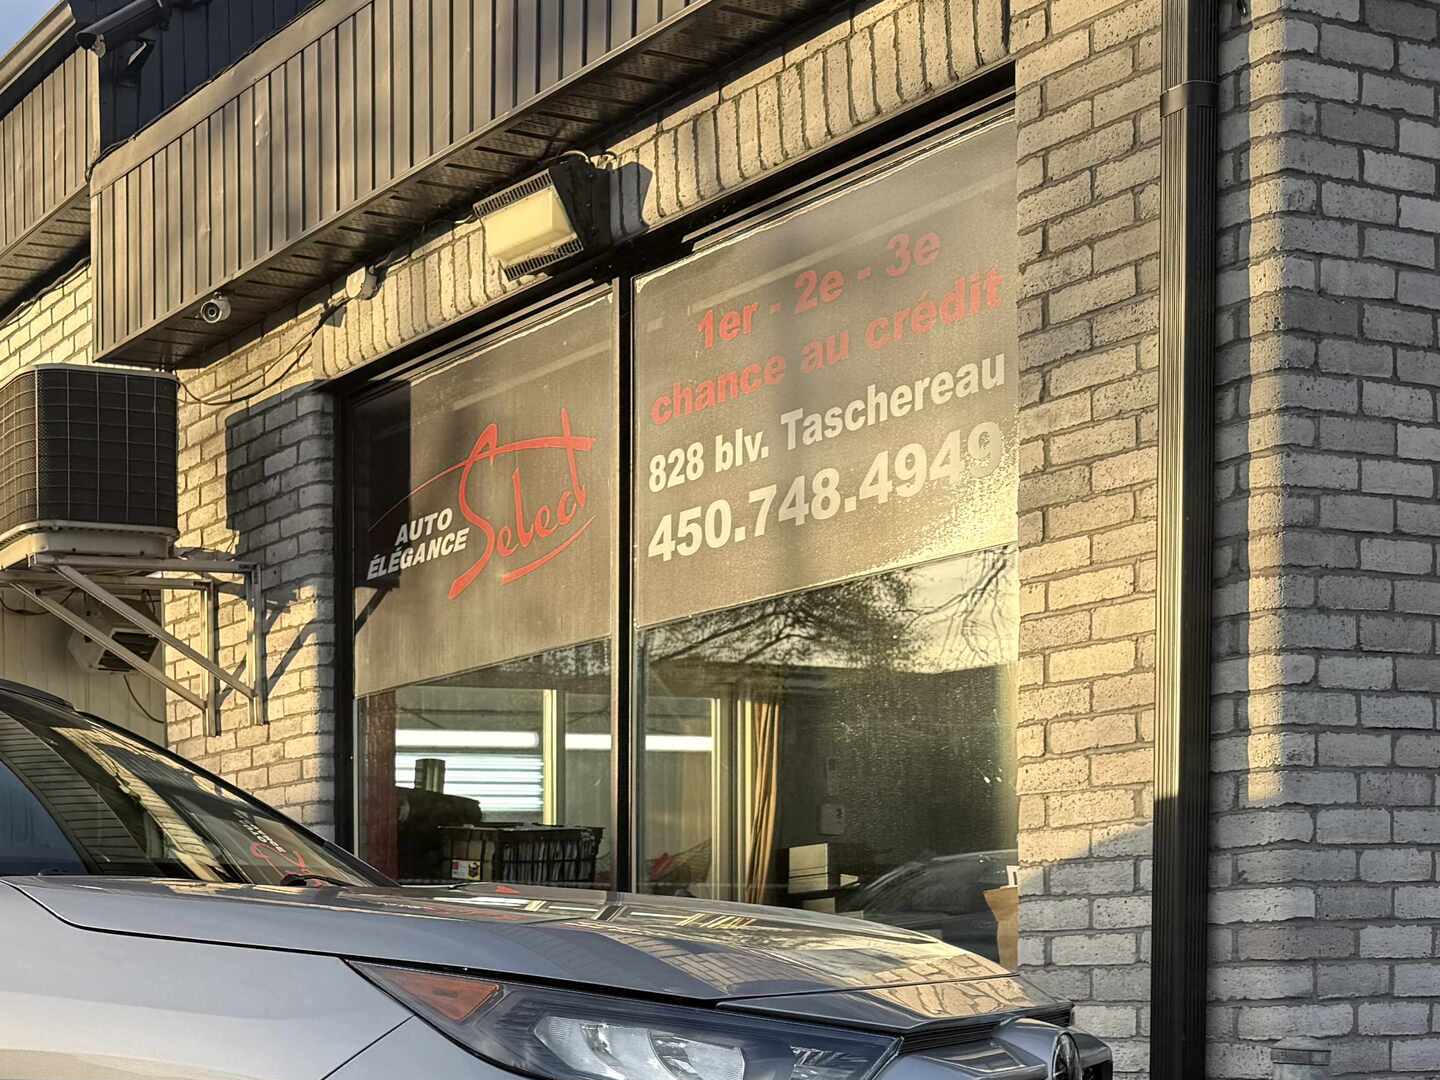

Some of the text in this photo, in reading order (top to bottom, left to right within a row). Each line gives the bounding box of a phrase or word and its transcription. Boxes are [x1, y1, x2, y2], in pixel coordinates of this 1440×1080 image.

[650, 264, 1004, 426] chance au crédit
[698, 302, 758, 350] 1er
[793, 269, 845, 315] 2e
[886, 230, 942, 278] 3e
[647, 421, 1003, 563] 450.748.4949
[648, 352, 1006, 494] 828 blv. Taschereau
[366, 527, 471, 582] ÉLÉGANCE
[394, 507, 454, 547] AUTO
[447, 407, 597, 601] Select
